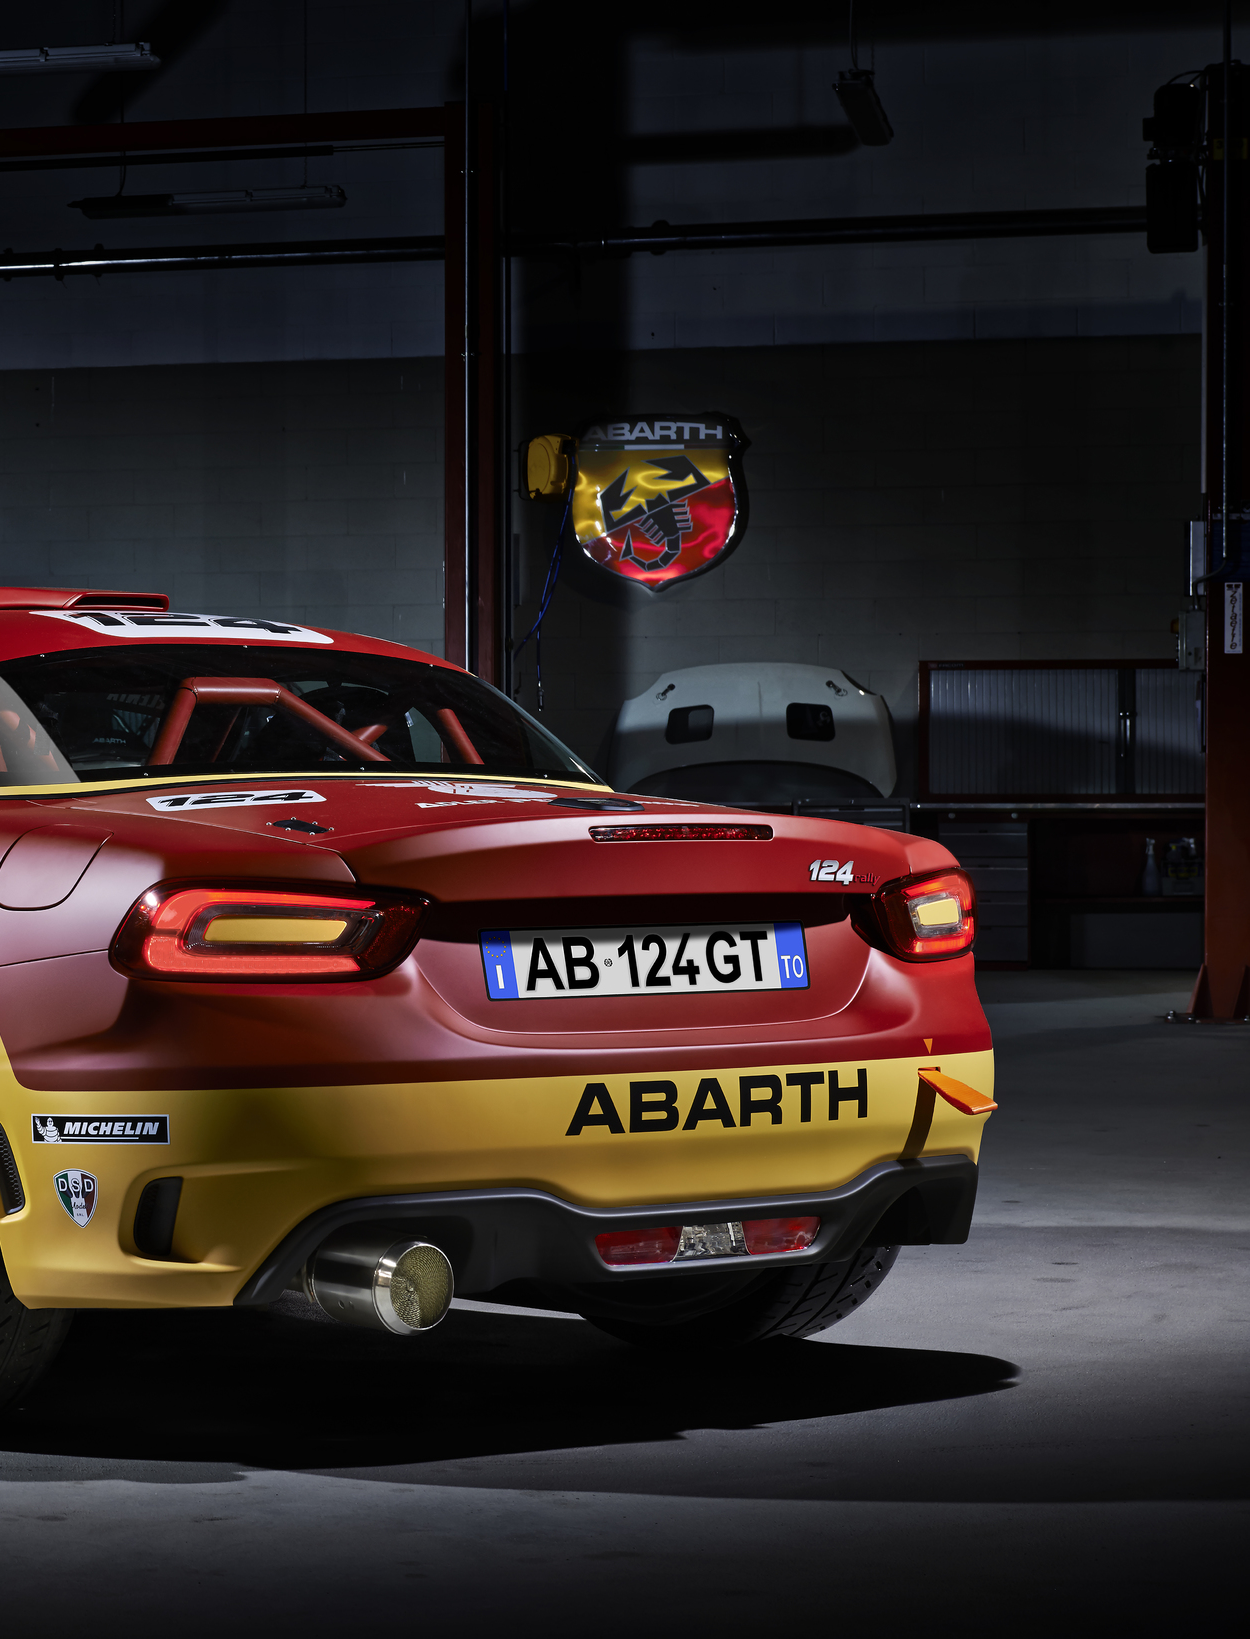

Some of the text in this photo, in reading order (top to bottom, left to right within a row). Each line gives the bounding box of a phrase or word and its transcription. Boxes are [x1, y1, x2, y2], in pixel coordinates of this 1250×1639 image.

[585, 421, 723, 441] ABARTH
[64, 612, 302, 634] 124
[158, 792, 314, 807] 124
[808, 859, 881, 886] 124 rally
[526, 936, 600, 991] AB
[617, 931, 700, 989] 124
[705, 930, 768, 984] GT
[780, 954, 804, 979] TO
[565, 1068, 868, 1136] ABARTH
[63, 1121, 160, 1136] MICHELIN
[58, 1178, 94, 1192] DSD
